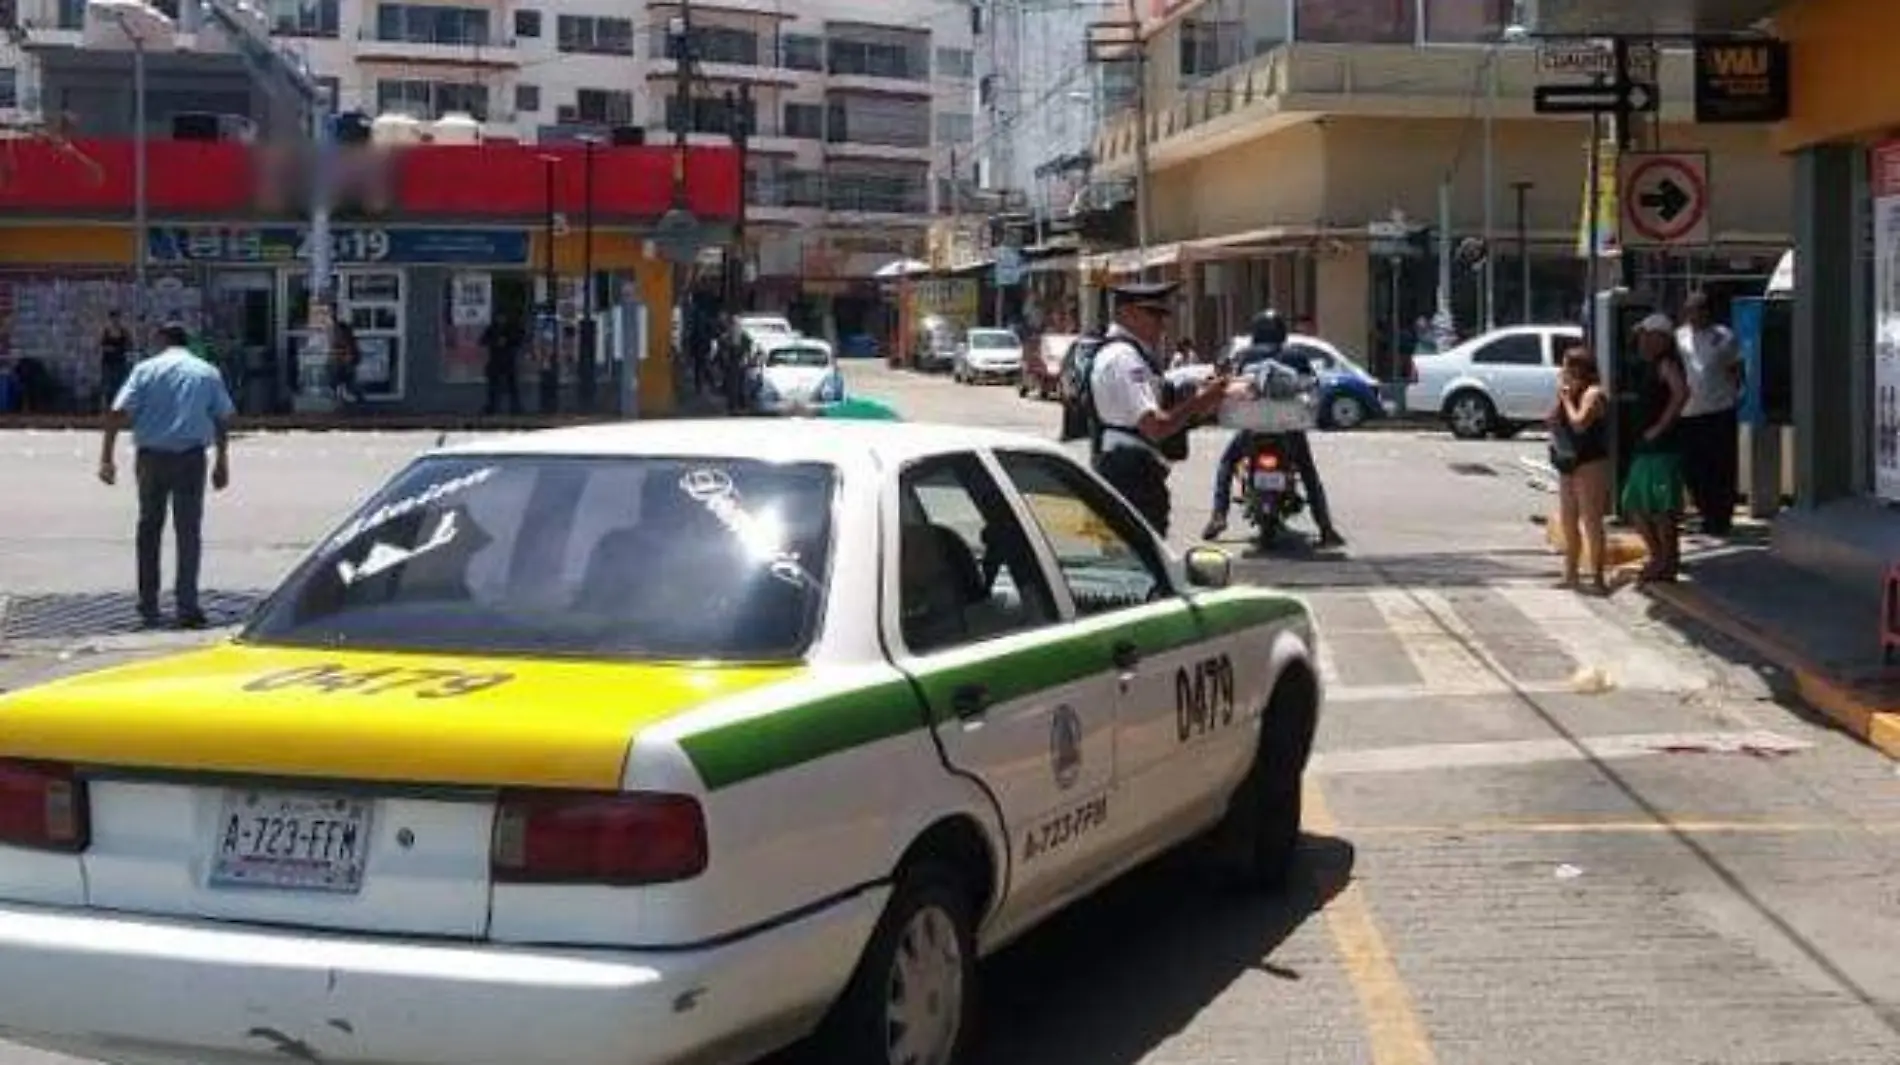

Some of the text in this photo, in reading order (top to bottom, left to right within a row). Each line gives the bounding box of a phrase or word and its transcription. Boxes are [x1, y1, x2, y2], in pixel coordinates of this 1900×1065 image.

[242, 663, 515, 699] 0479
[1175, 652, 1234, 743] 0479
[222, 813, 357, 860] A-723-FFM
